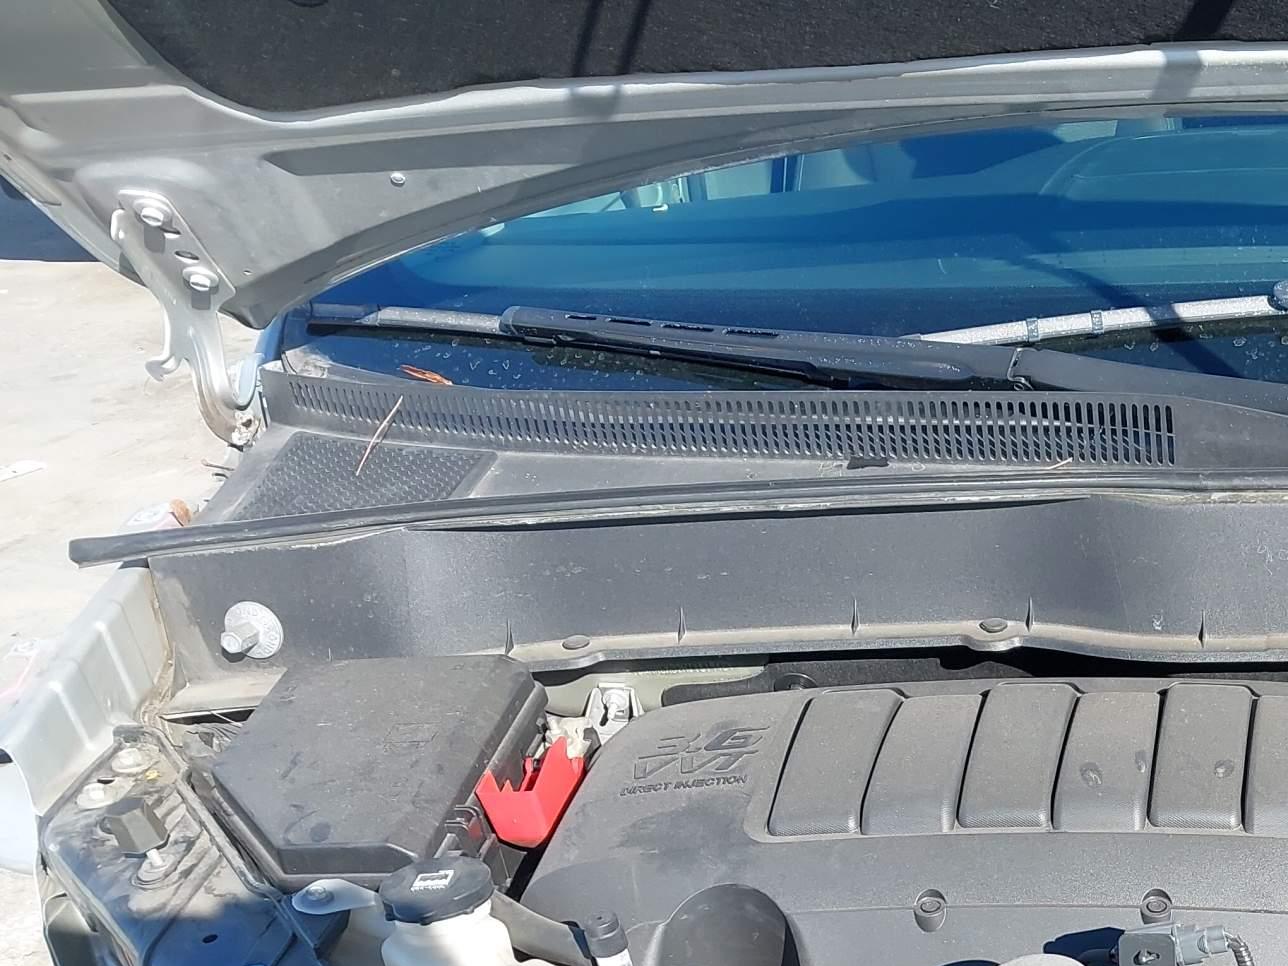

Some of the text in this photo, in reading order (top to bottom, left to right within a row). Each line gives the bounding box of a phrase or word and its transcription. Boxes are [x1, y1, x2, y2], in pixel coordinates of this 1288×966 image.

[633, 749, 759, 780] VVT
[619, 773, 748, 797] DIRECT INJECTION
